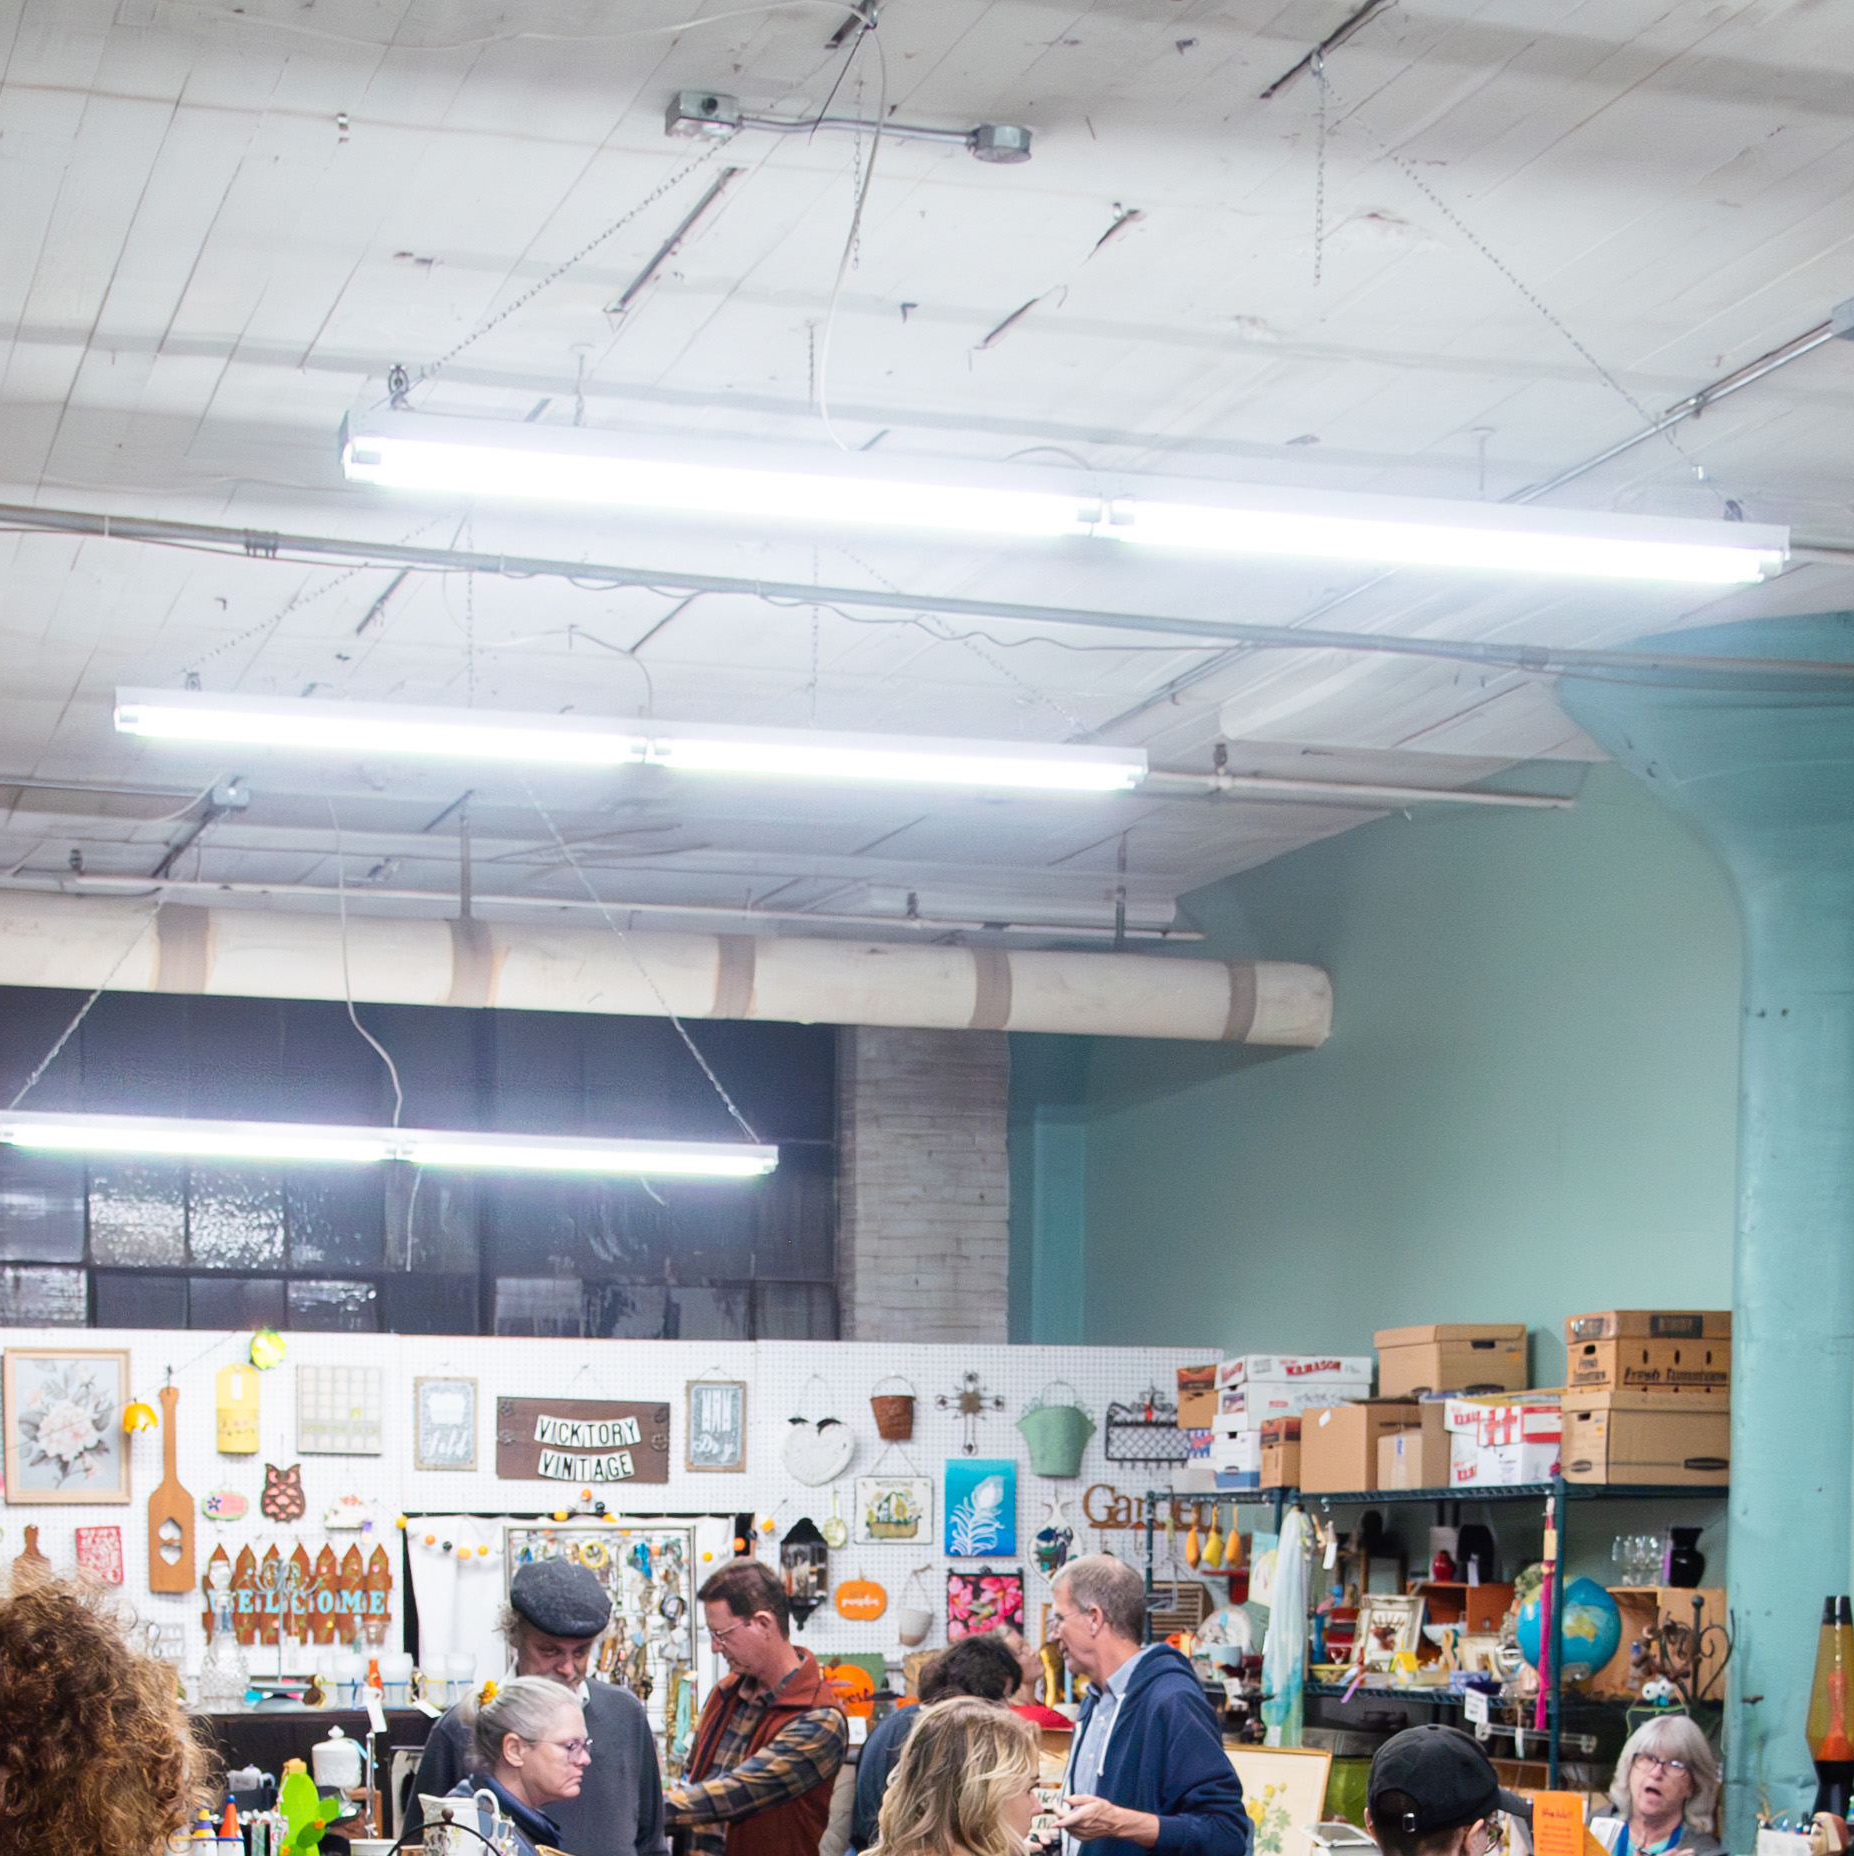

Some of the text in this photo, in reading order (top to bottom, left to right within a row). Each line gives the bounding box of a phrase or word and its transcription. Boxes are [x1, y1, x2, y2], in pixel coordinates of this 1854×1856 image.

[540, 1418, 638, 1446] VICKTORY
[543, 1452, 632, 1481] VINTAGE
[207, 1589, 386, 1615] ELCOME
